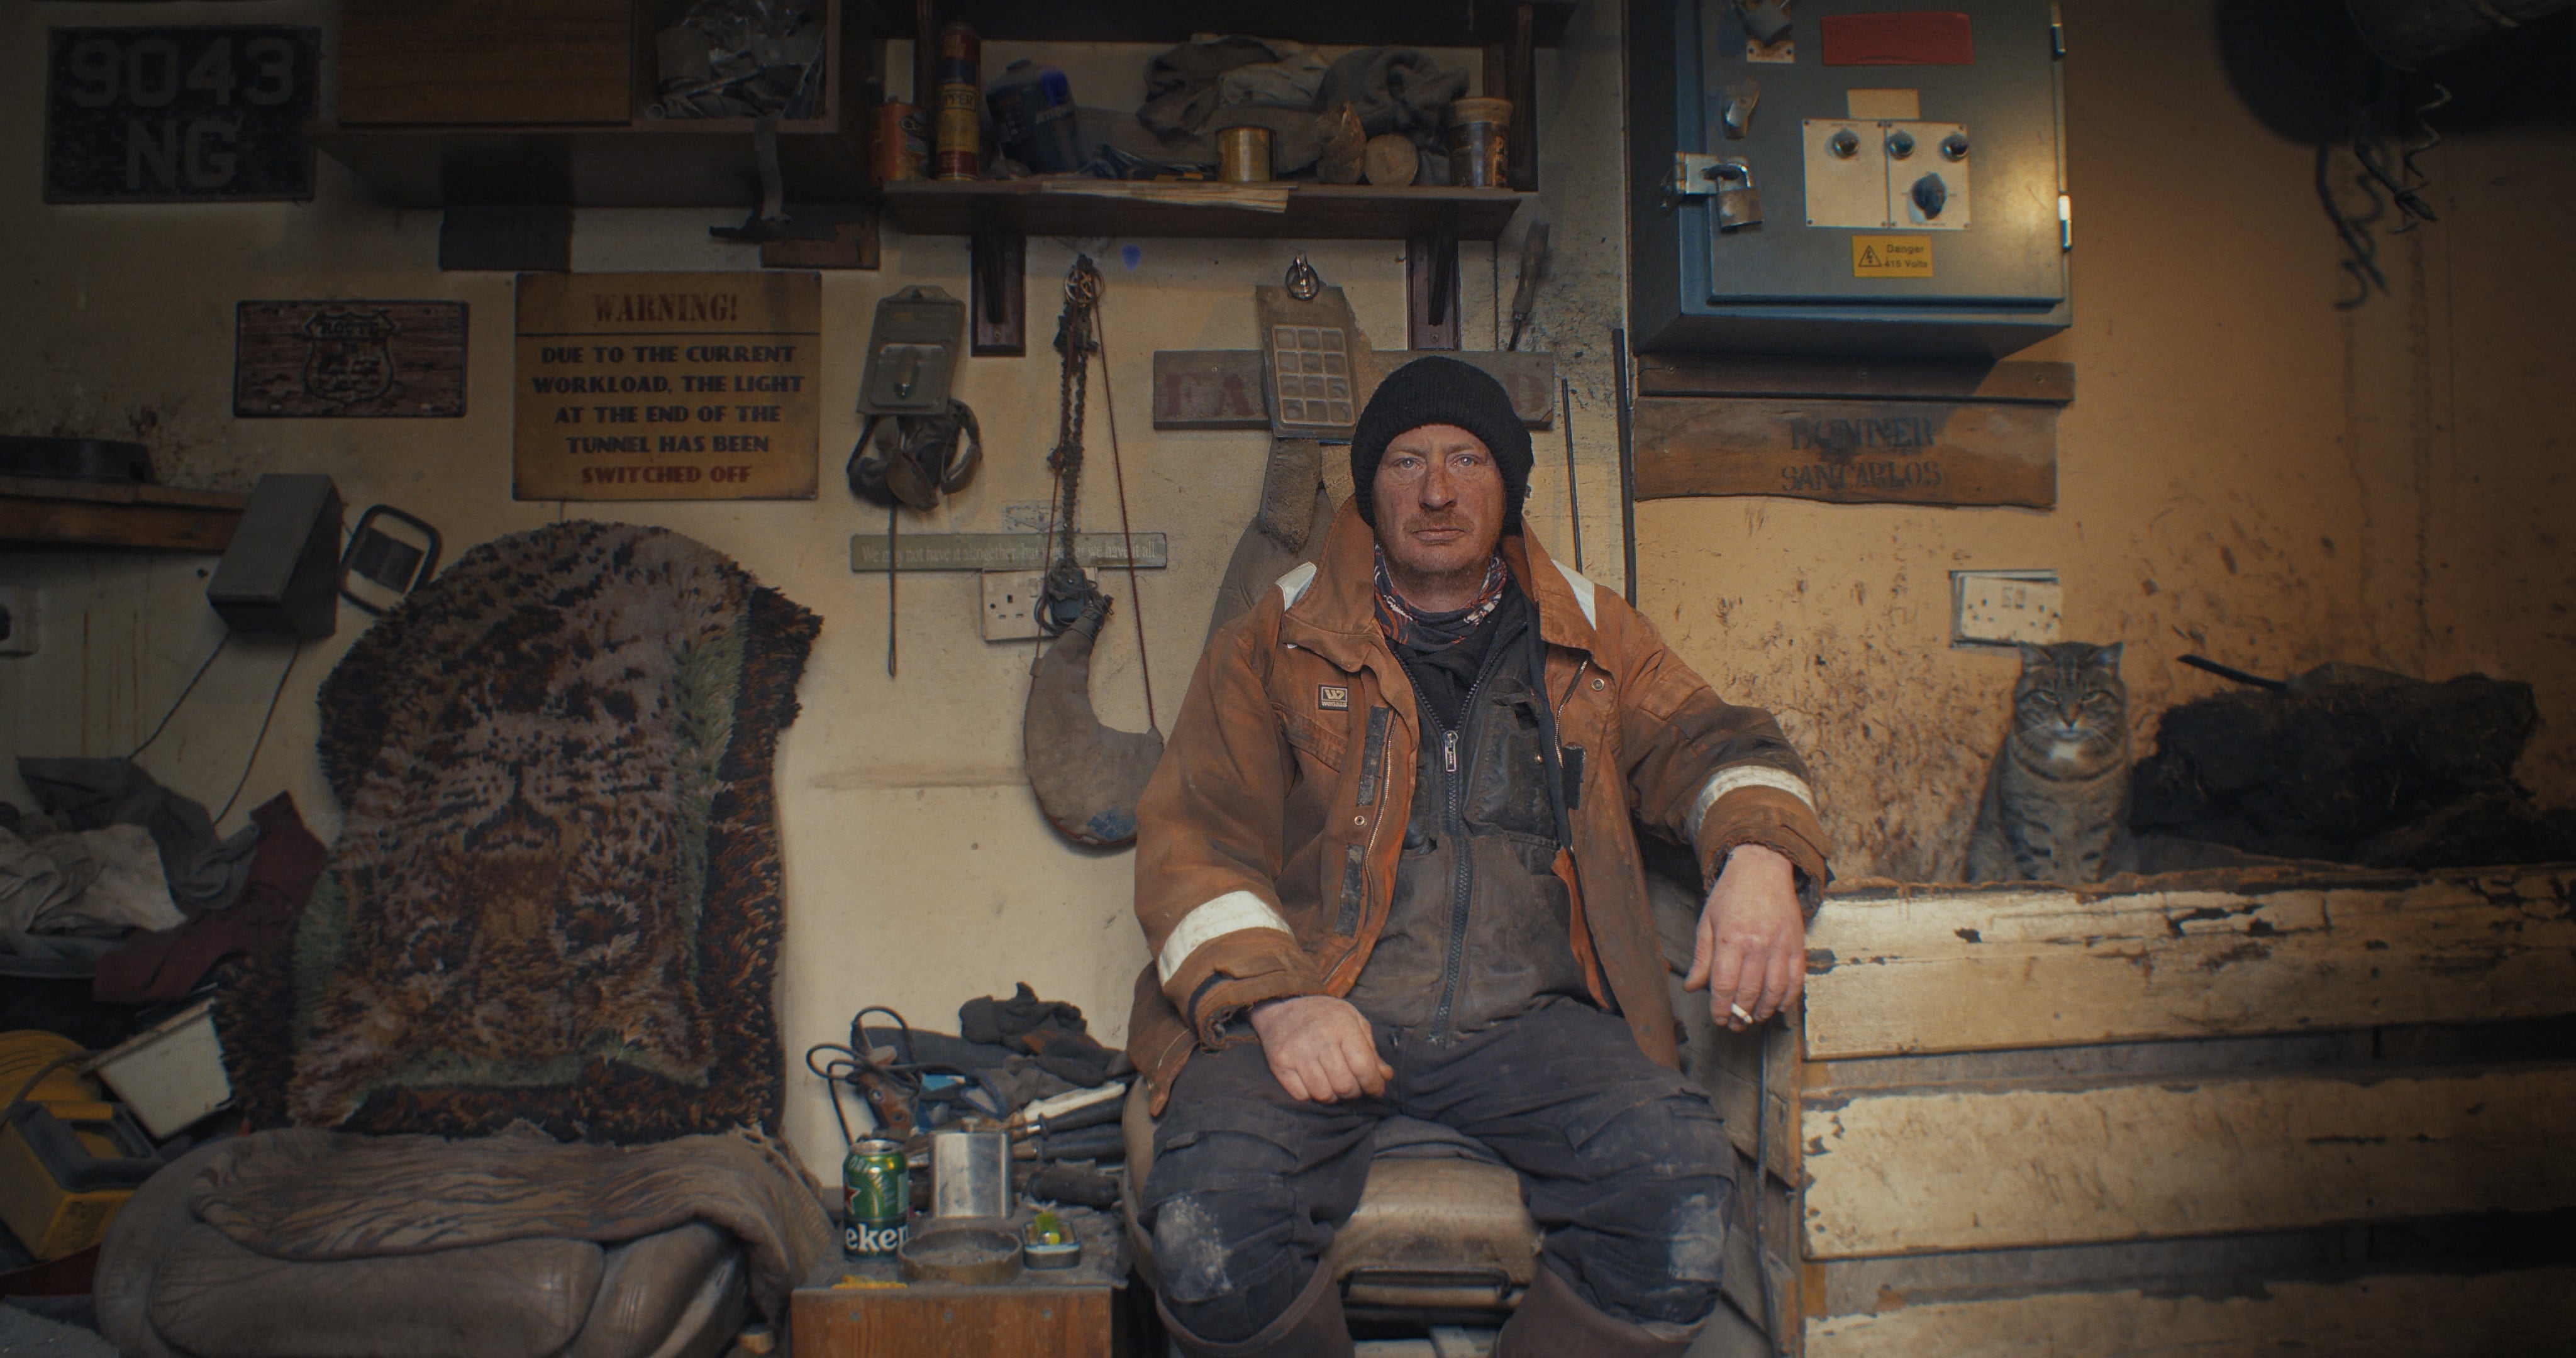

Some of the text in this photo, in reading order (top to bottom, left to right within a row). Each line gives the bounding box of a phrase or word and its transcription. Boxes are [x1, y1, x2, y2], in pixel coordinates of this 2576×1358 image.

[70, 37, 294, 108] 9043
[125, 117, 239, 192] NG
[1886, 245, 1924, 254] Danger
[1905, 260, 1928, 268] Volts
[592, 292, 738, 322] WARNING!
[541, 345, 796, 364] DUE TO THE CURRENT
[532, 375, 805, 394] WORKLOAD, THE LIGHT
[555, 406, 781, 424] AT THE END OF THE
[1790, 417, 1935, 449] BONNER
[566, 436, 769, 453] TUNNEL HAS BEEN
[582, 466, 751, 483] SWITCHED OFF
[862, 546, 879, 562] We
[881, 550, 903, 567] my
[905, 549, 922, 561] not
[1087, 548, 1102, 559] we
[1142, 541, 1156, 558] all
